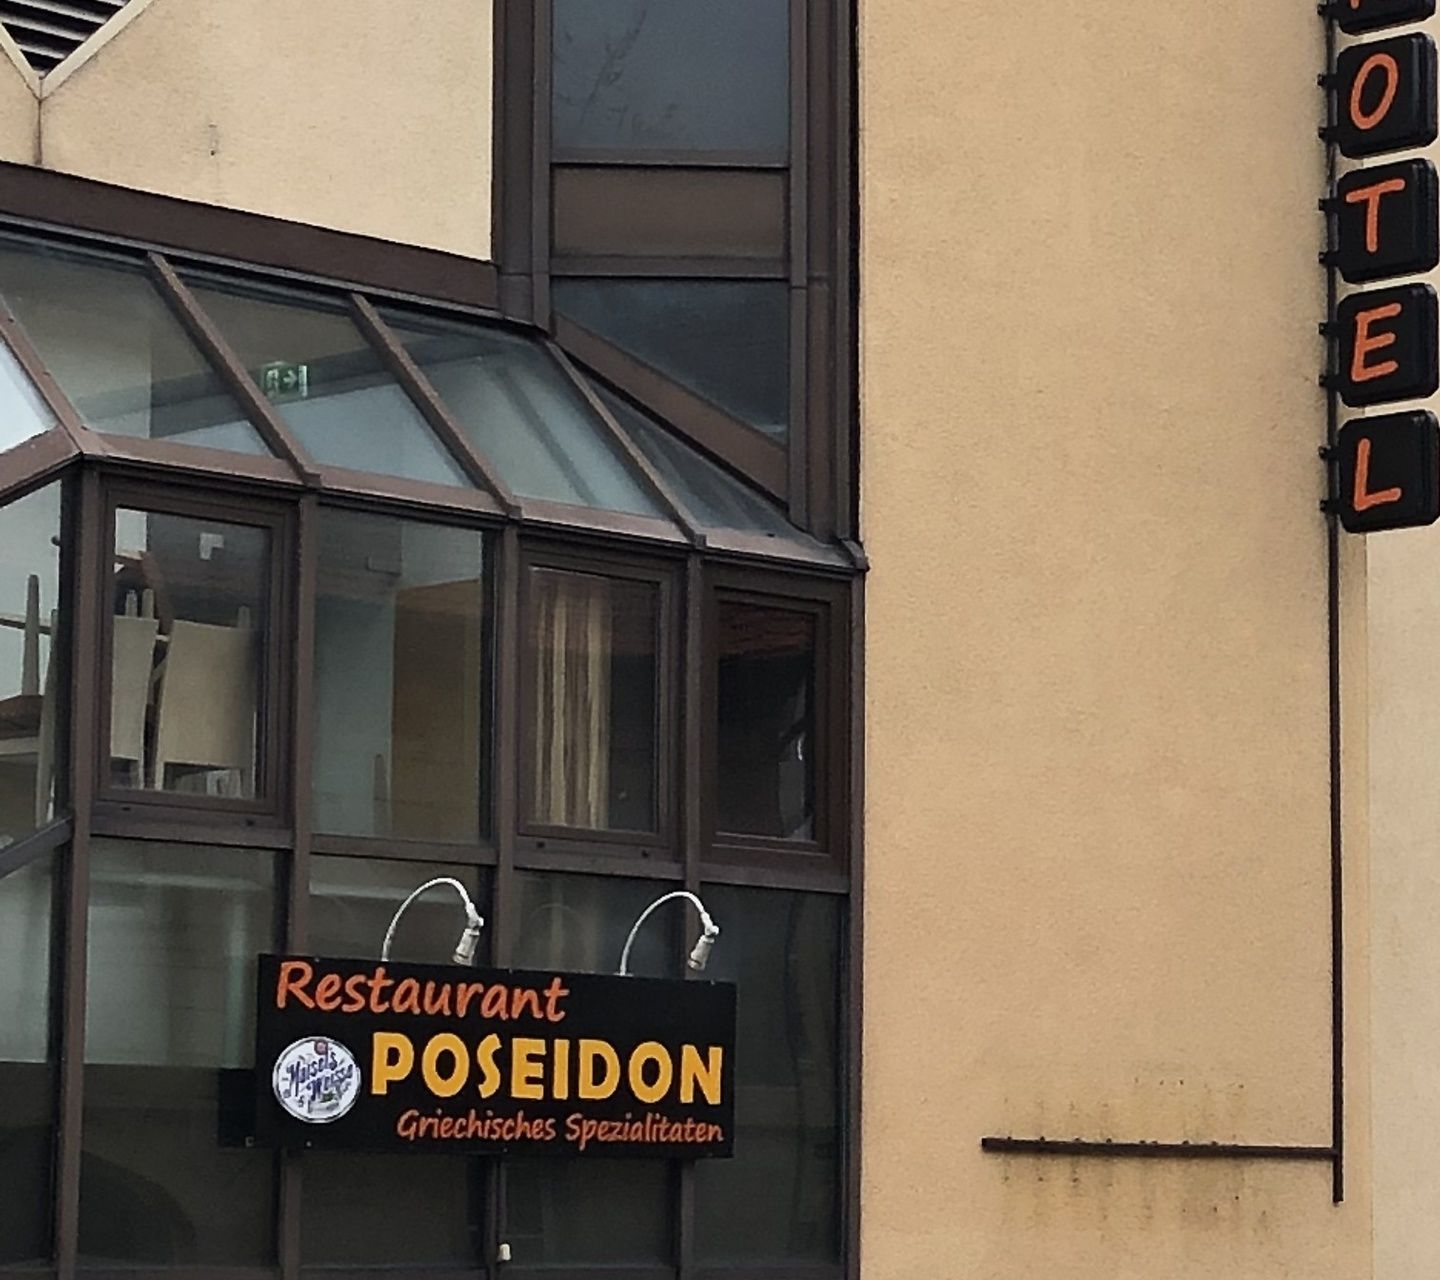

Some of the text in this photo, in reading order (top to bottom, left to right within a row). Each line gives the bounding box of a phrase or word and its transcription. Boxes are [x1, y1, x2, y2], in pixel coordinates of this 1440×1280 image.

[276, 961, 570, 1022] Restaurant
[371, 1031, 723, 1105] POSEIDON
[396, 1108, 556, 1142] Griechisches
